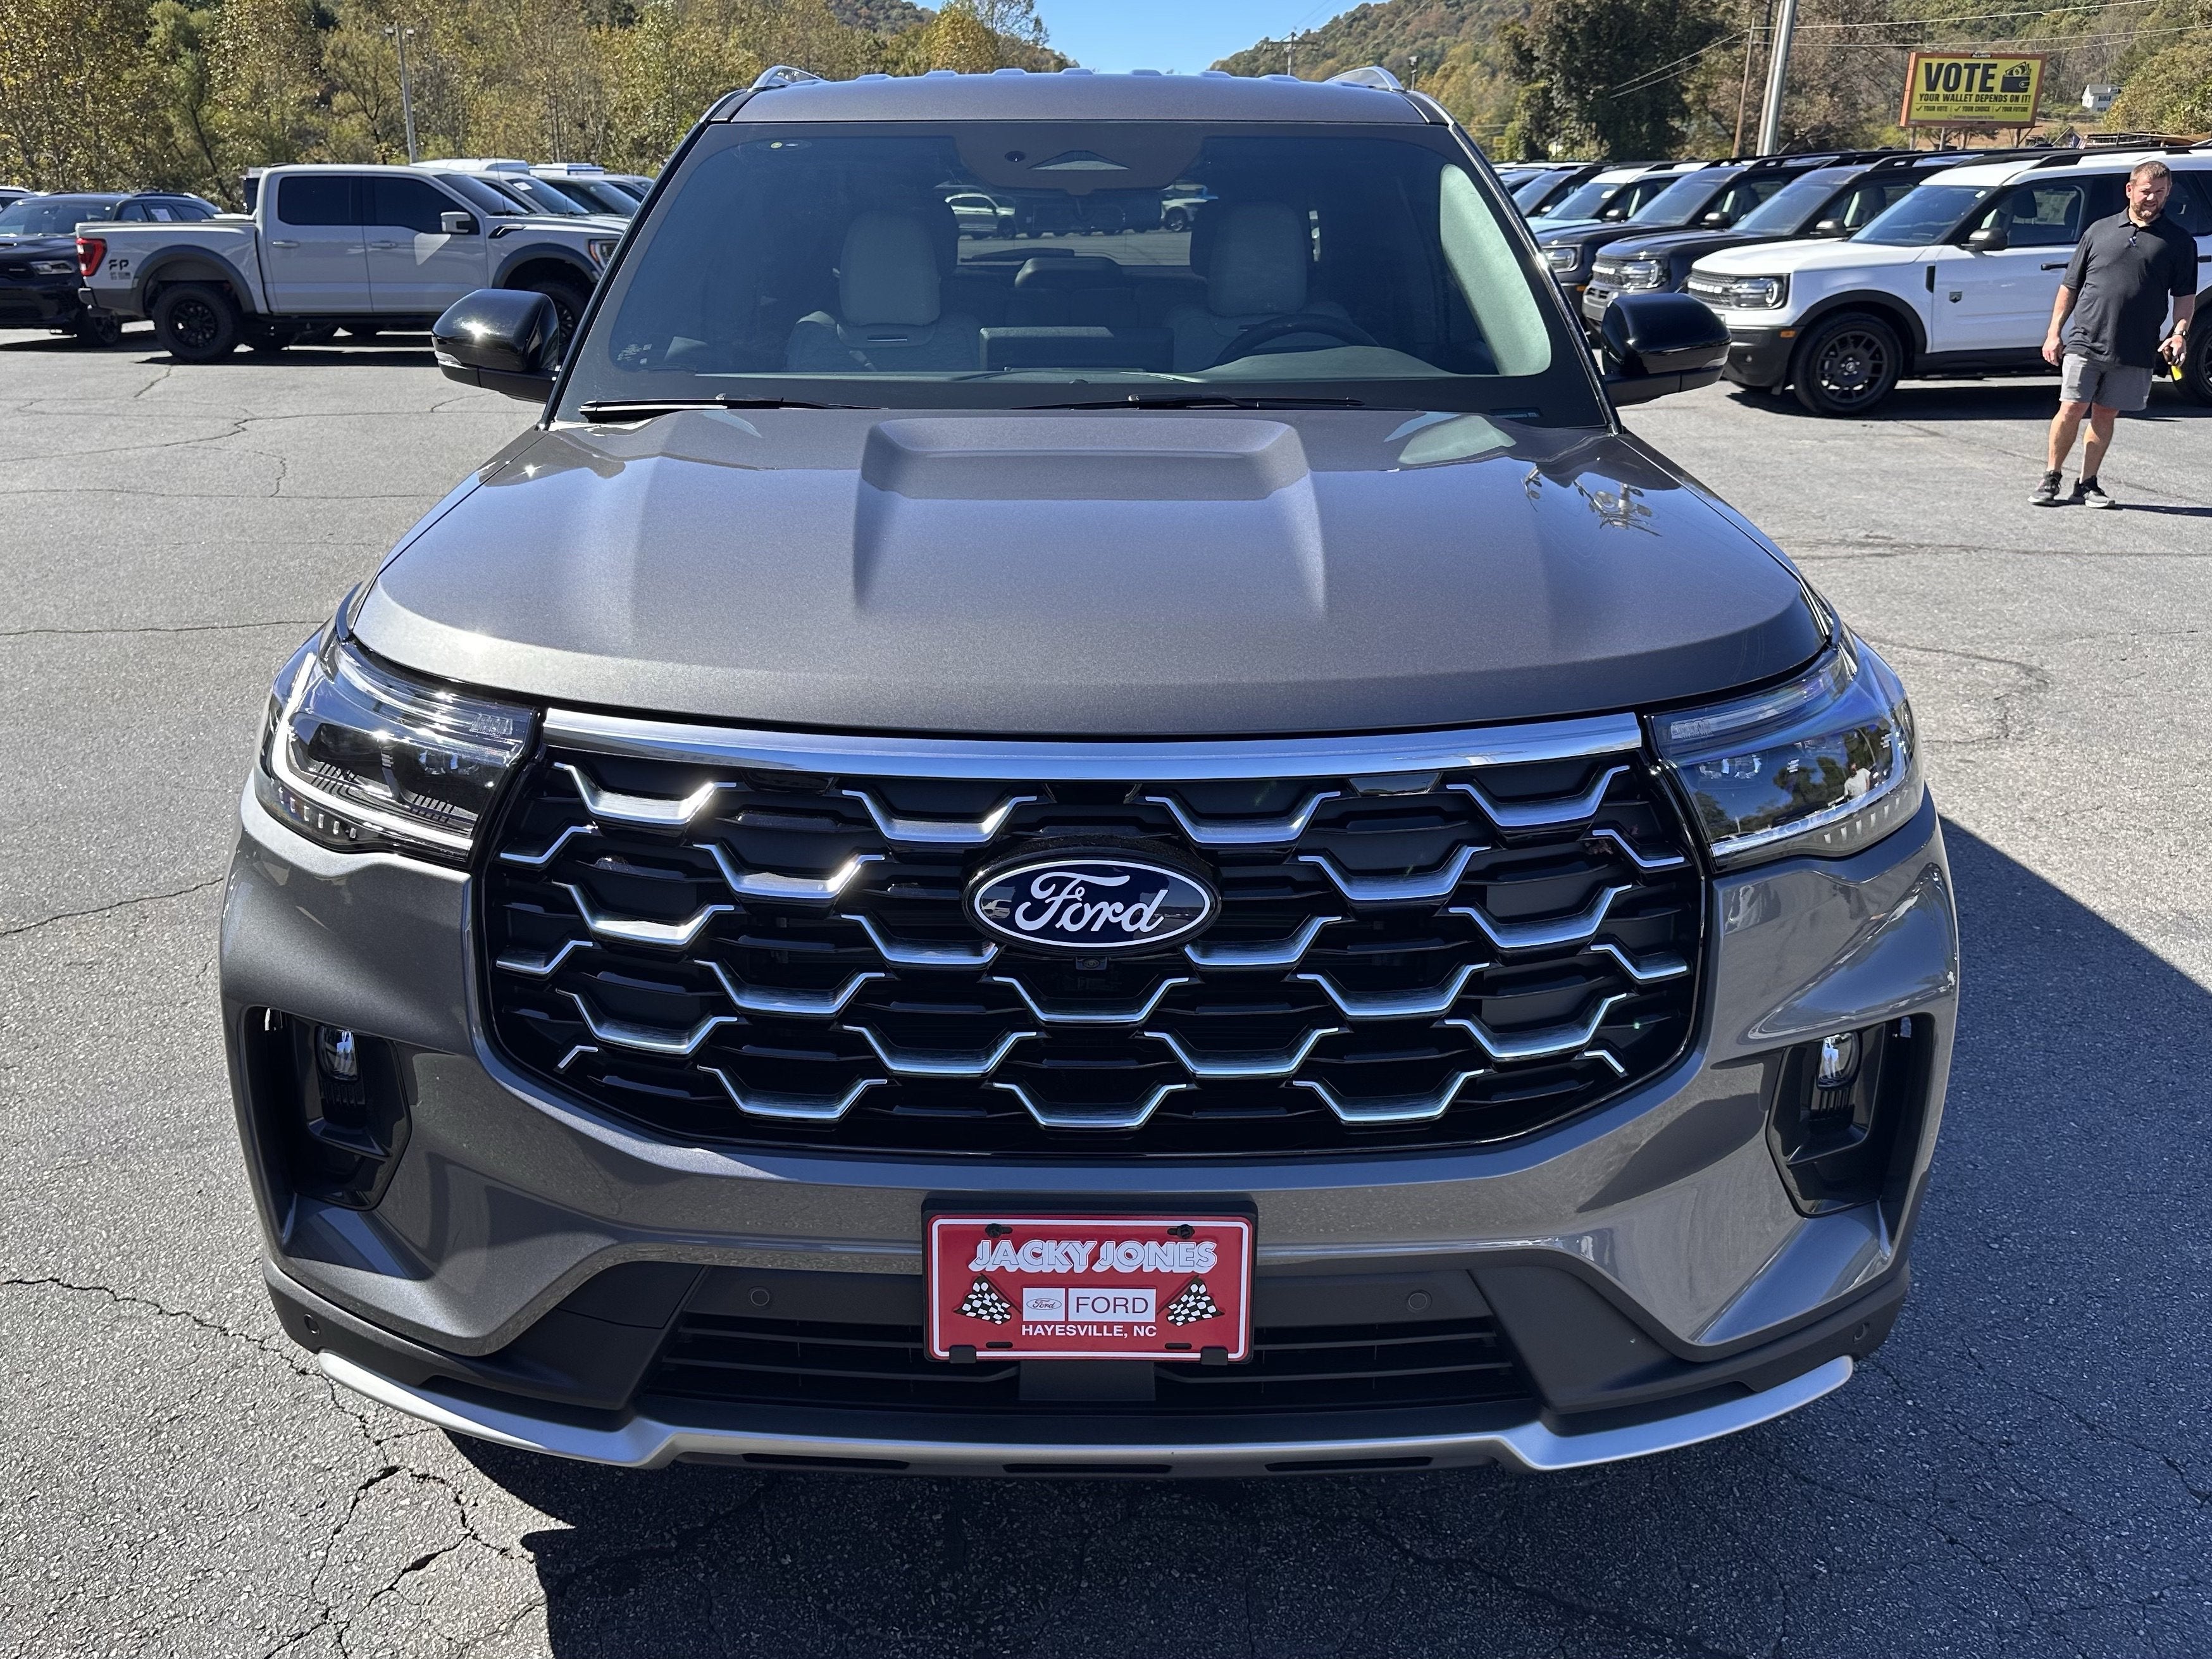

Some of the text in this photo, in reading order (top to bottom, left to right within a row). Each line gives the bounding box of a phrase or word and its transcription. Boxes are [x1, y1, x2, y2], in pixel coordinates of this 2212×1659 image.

[1925, 63, 1998, 92] VOTE
[1919, 93, 1940, 102] YOUR
[1942, 94, 1973, 102] WALLET
[1975, 94, 2008, 103] DEPENDS
[2021, 95, 2031, 103] IT!
[108, 259, 129, 271] FP
[1015, 872, 1169, 932] Ford
[968, 1240, 1217, 1273] JACKY JONES
[1032, 1298, 1056, 1309] Ford
[1076, 1296, 1148, 1314] FORD
[1021, 1324, 1157, 1339] HAYESVILLE, NC
